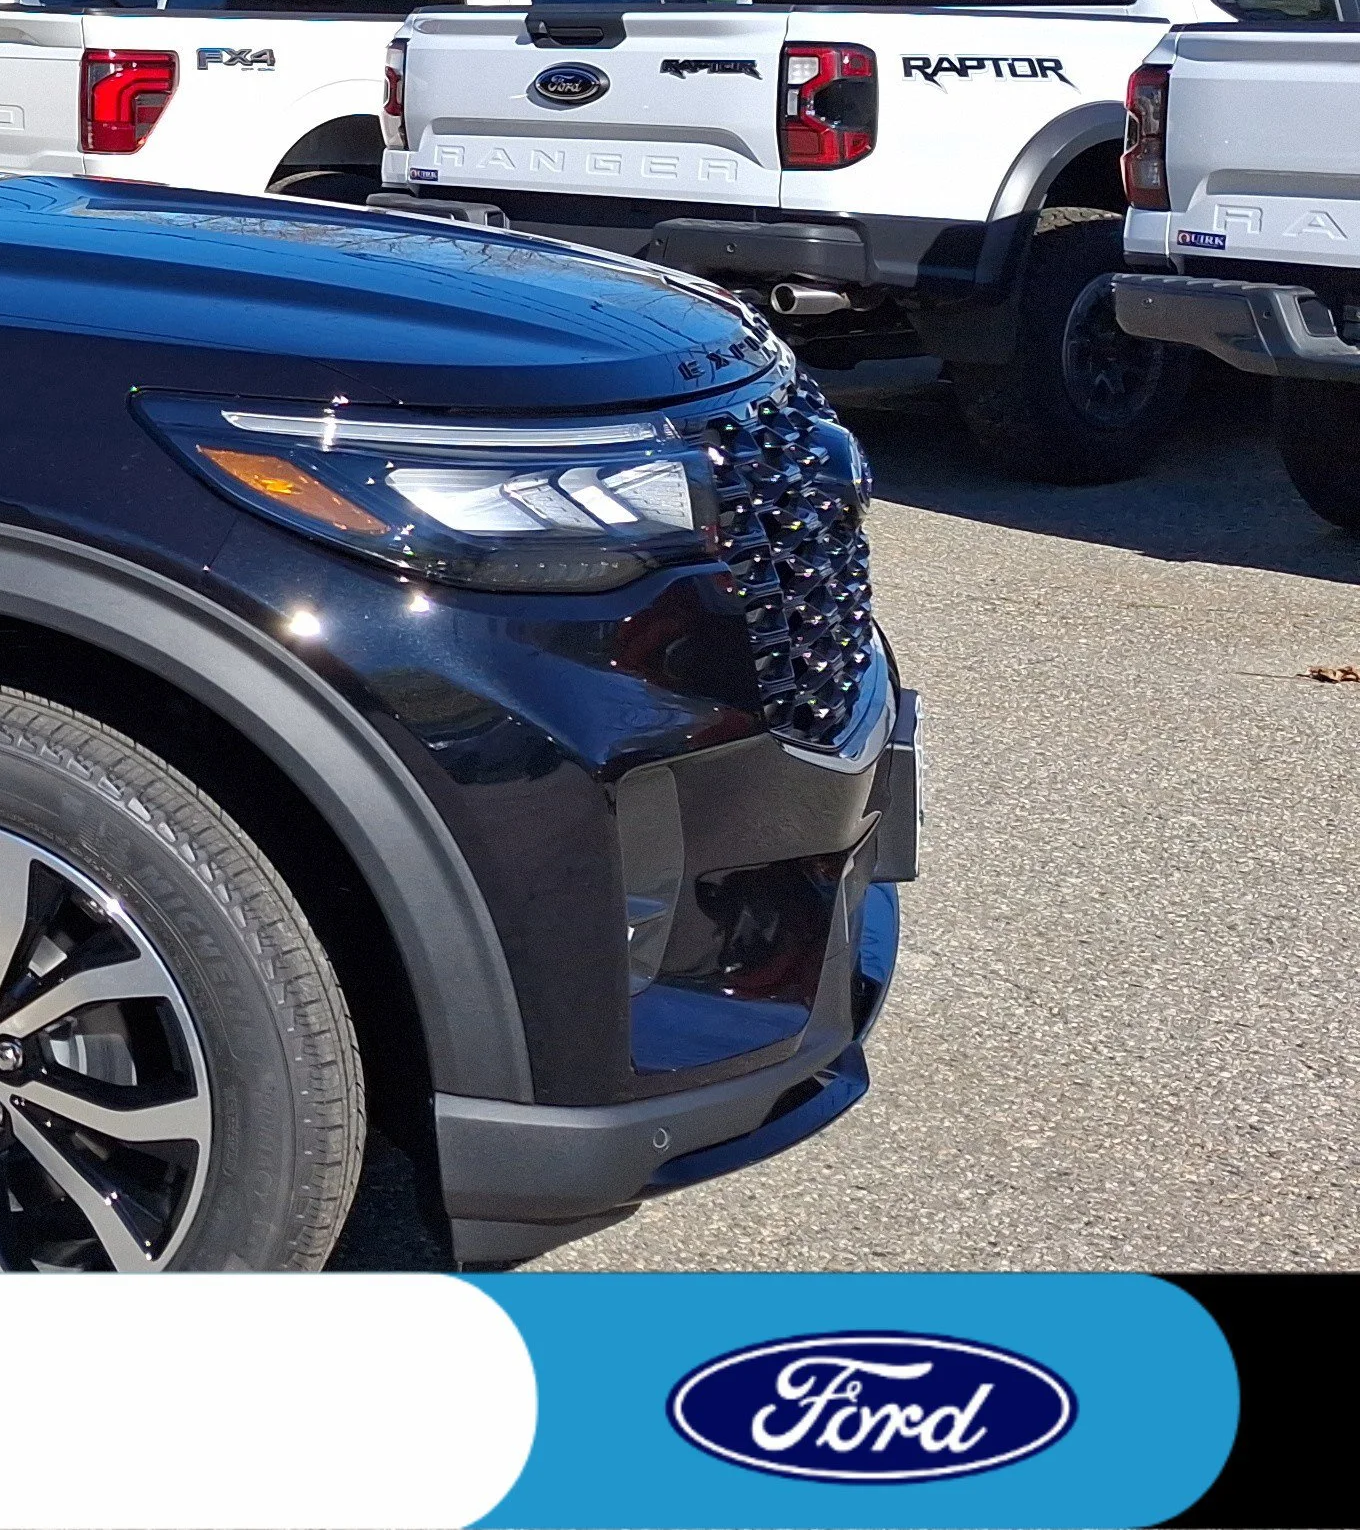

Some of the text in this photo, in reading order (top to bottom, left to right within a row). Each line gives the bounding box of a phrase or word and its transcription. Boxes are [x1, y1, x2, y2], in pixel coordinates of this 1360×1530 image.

[196, 47, 276, 70] FX4
[547, 74, 582, 94] Ford
[900, 55, 1081, 94] RAPTOR
[433, 144, 739, 183] RANGER
[1178, 231, 1225, 247] QUIRK
